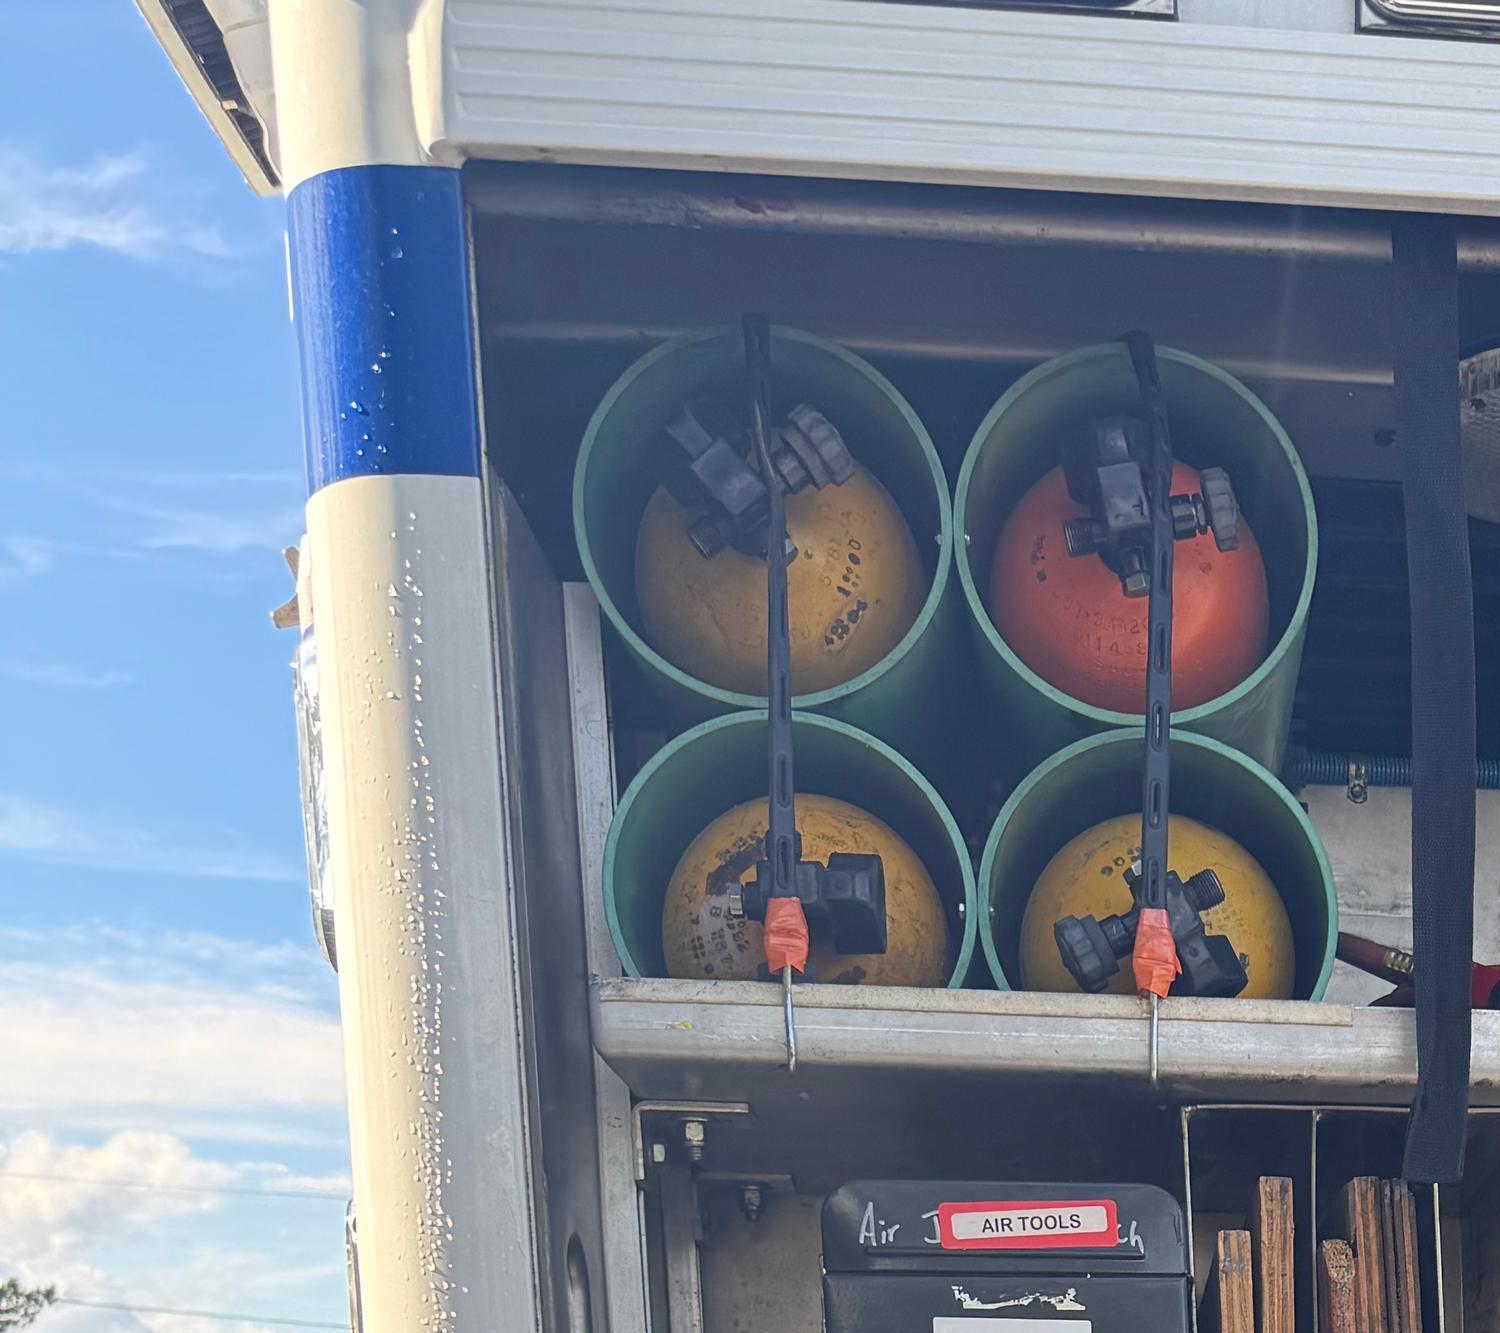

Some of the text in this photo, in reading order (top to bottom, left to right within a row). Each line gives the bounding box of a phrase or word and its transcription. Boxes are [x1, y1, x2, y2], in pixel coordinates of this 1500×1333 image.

[859, 1201, 901, 1247] Air
[982, 1213, 1081, 1233] AIR TOOLS
